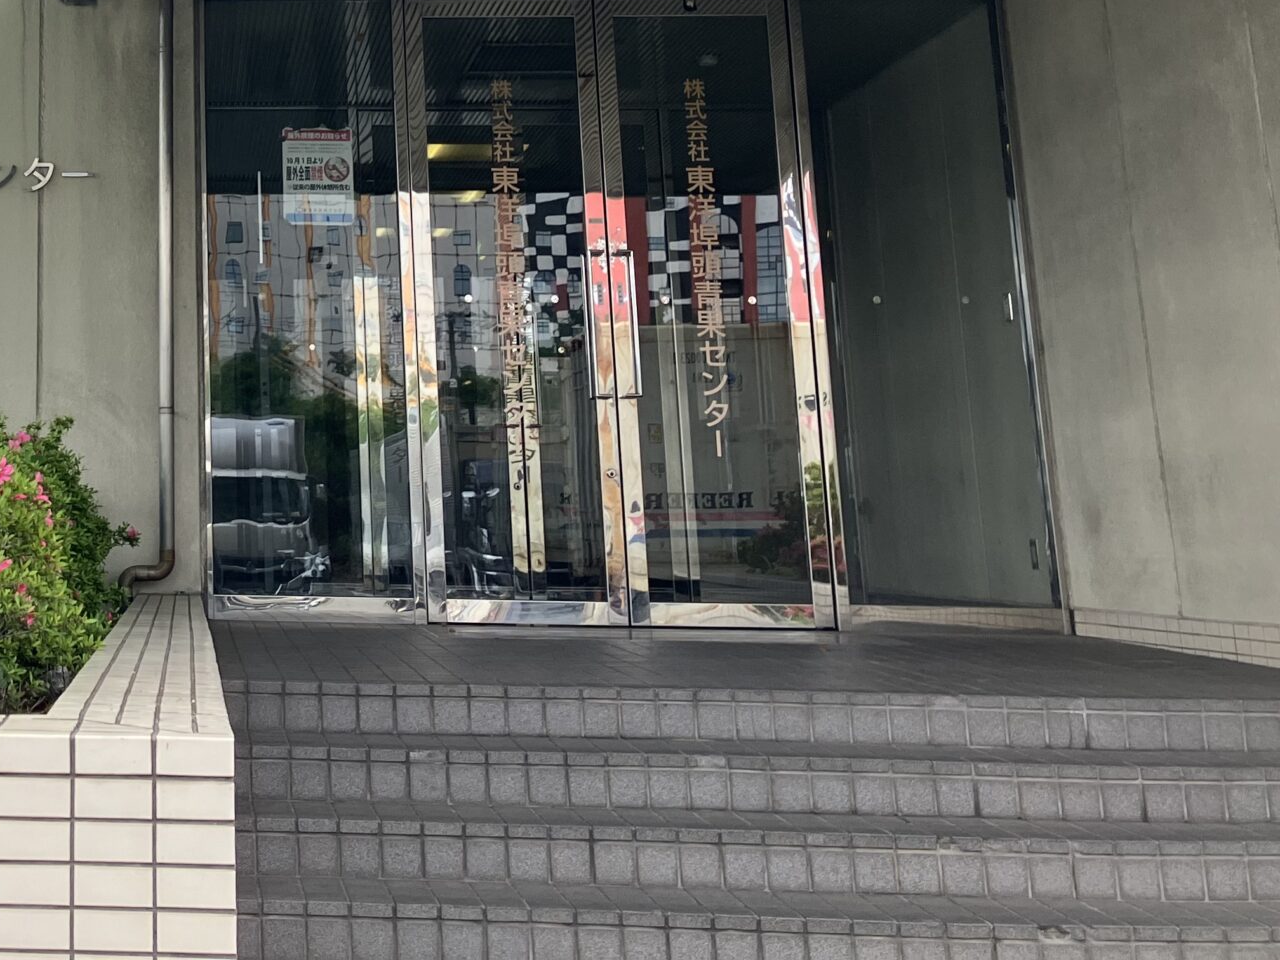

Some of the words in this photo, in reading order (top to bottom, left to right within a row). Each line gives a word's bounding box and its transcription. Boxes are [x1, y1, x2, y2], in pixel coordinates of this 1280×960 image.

[684, 78, 728, 457] 株式会社東洋埠頭青果センター
